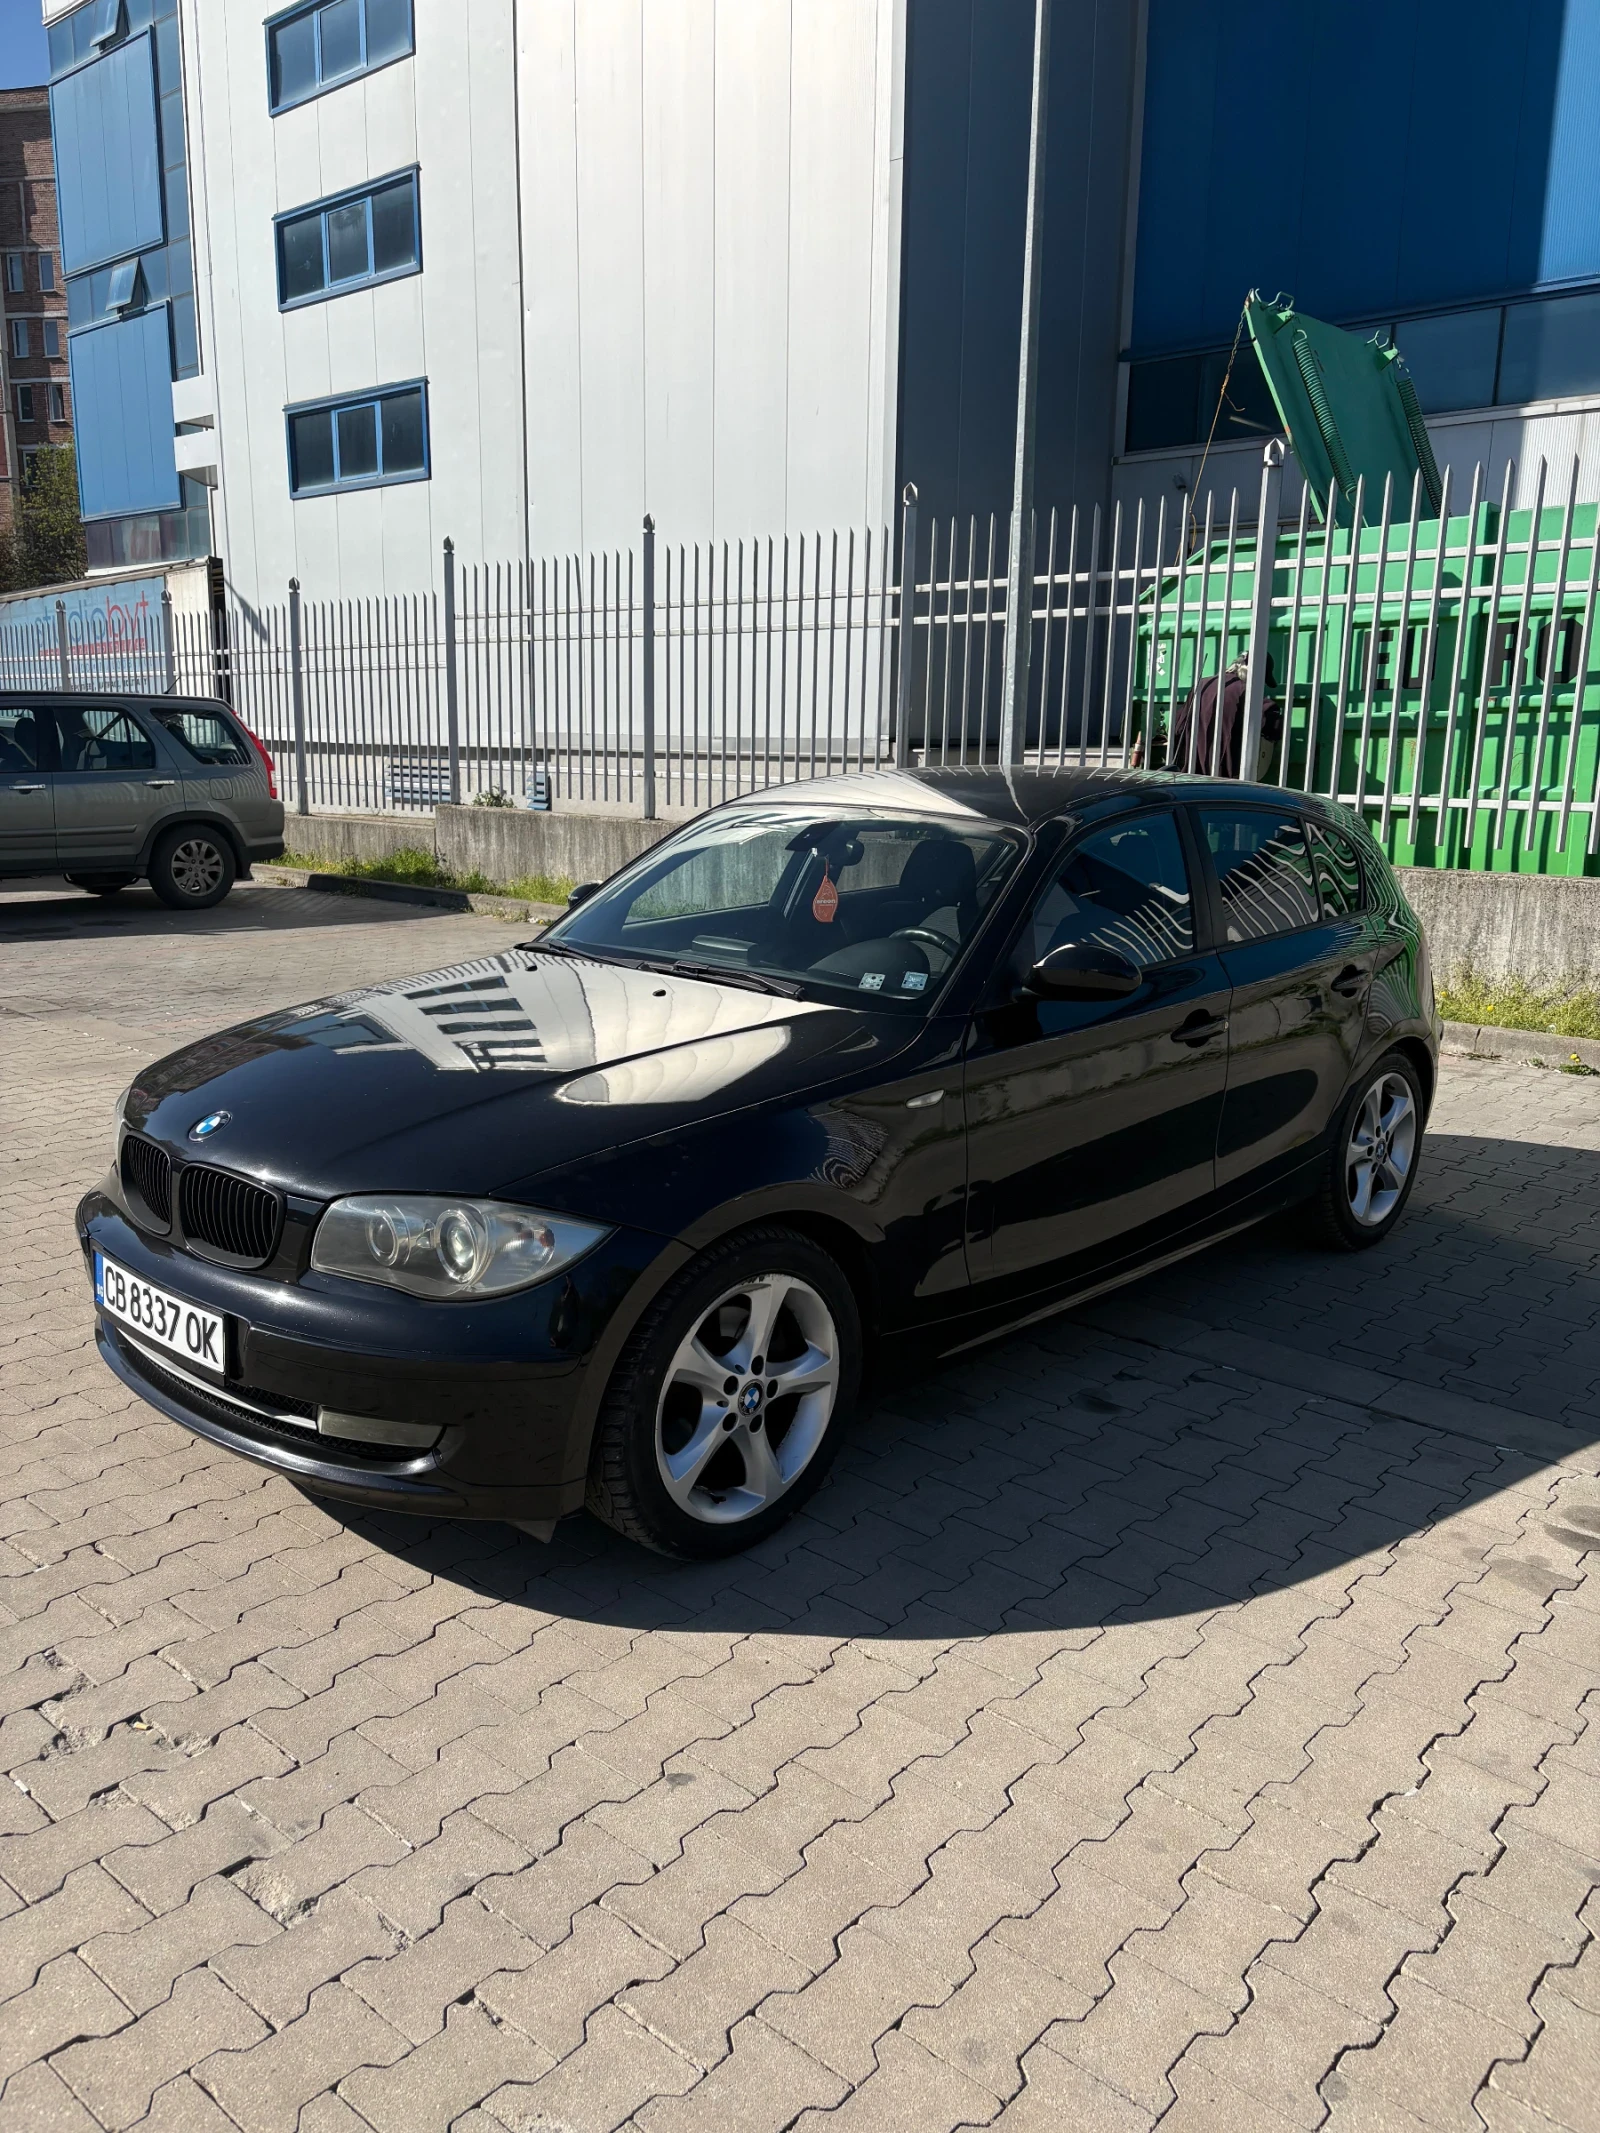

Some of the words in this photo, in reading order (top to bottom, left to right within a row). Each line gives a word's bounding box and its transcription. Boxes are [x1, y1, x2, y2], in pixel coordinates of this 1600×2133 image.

[105, 1265, 127, 1314] CB
[130, 1282, 181, 1343] 8337
[186, 1311, 219, 1364] OK
